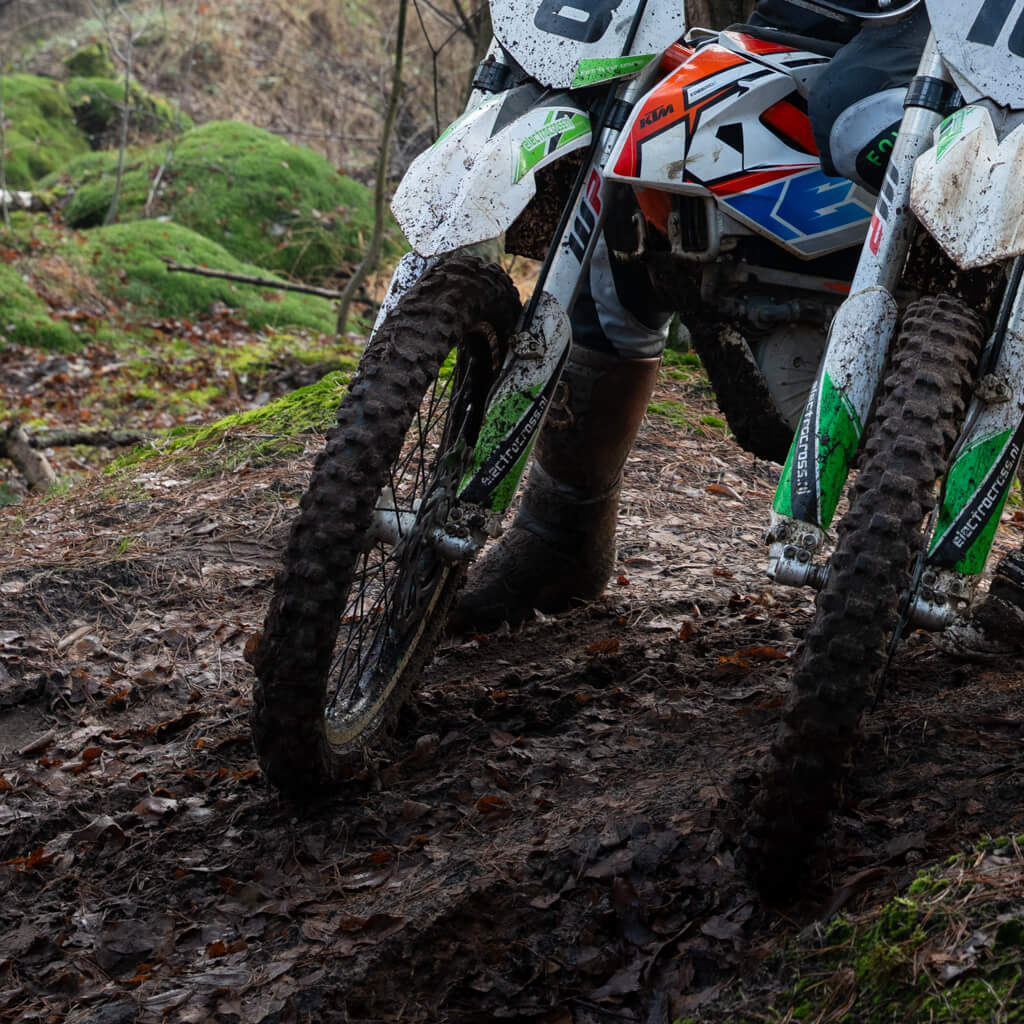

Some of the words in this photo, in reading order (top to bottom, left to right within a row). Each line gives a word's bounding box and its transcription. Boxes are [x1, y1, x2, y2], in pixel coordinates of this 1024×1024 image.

[639, 103, 675, 129] KTM
[865, 131, 899, 167] FO
[953, 443, 1020, 548] electrocross.nl
